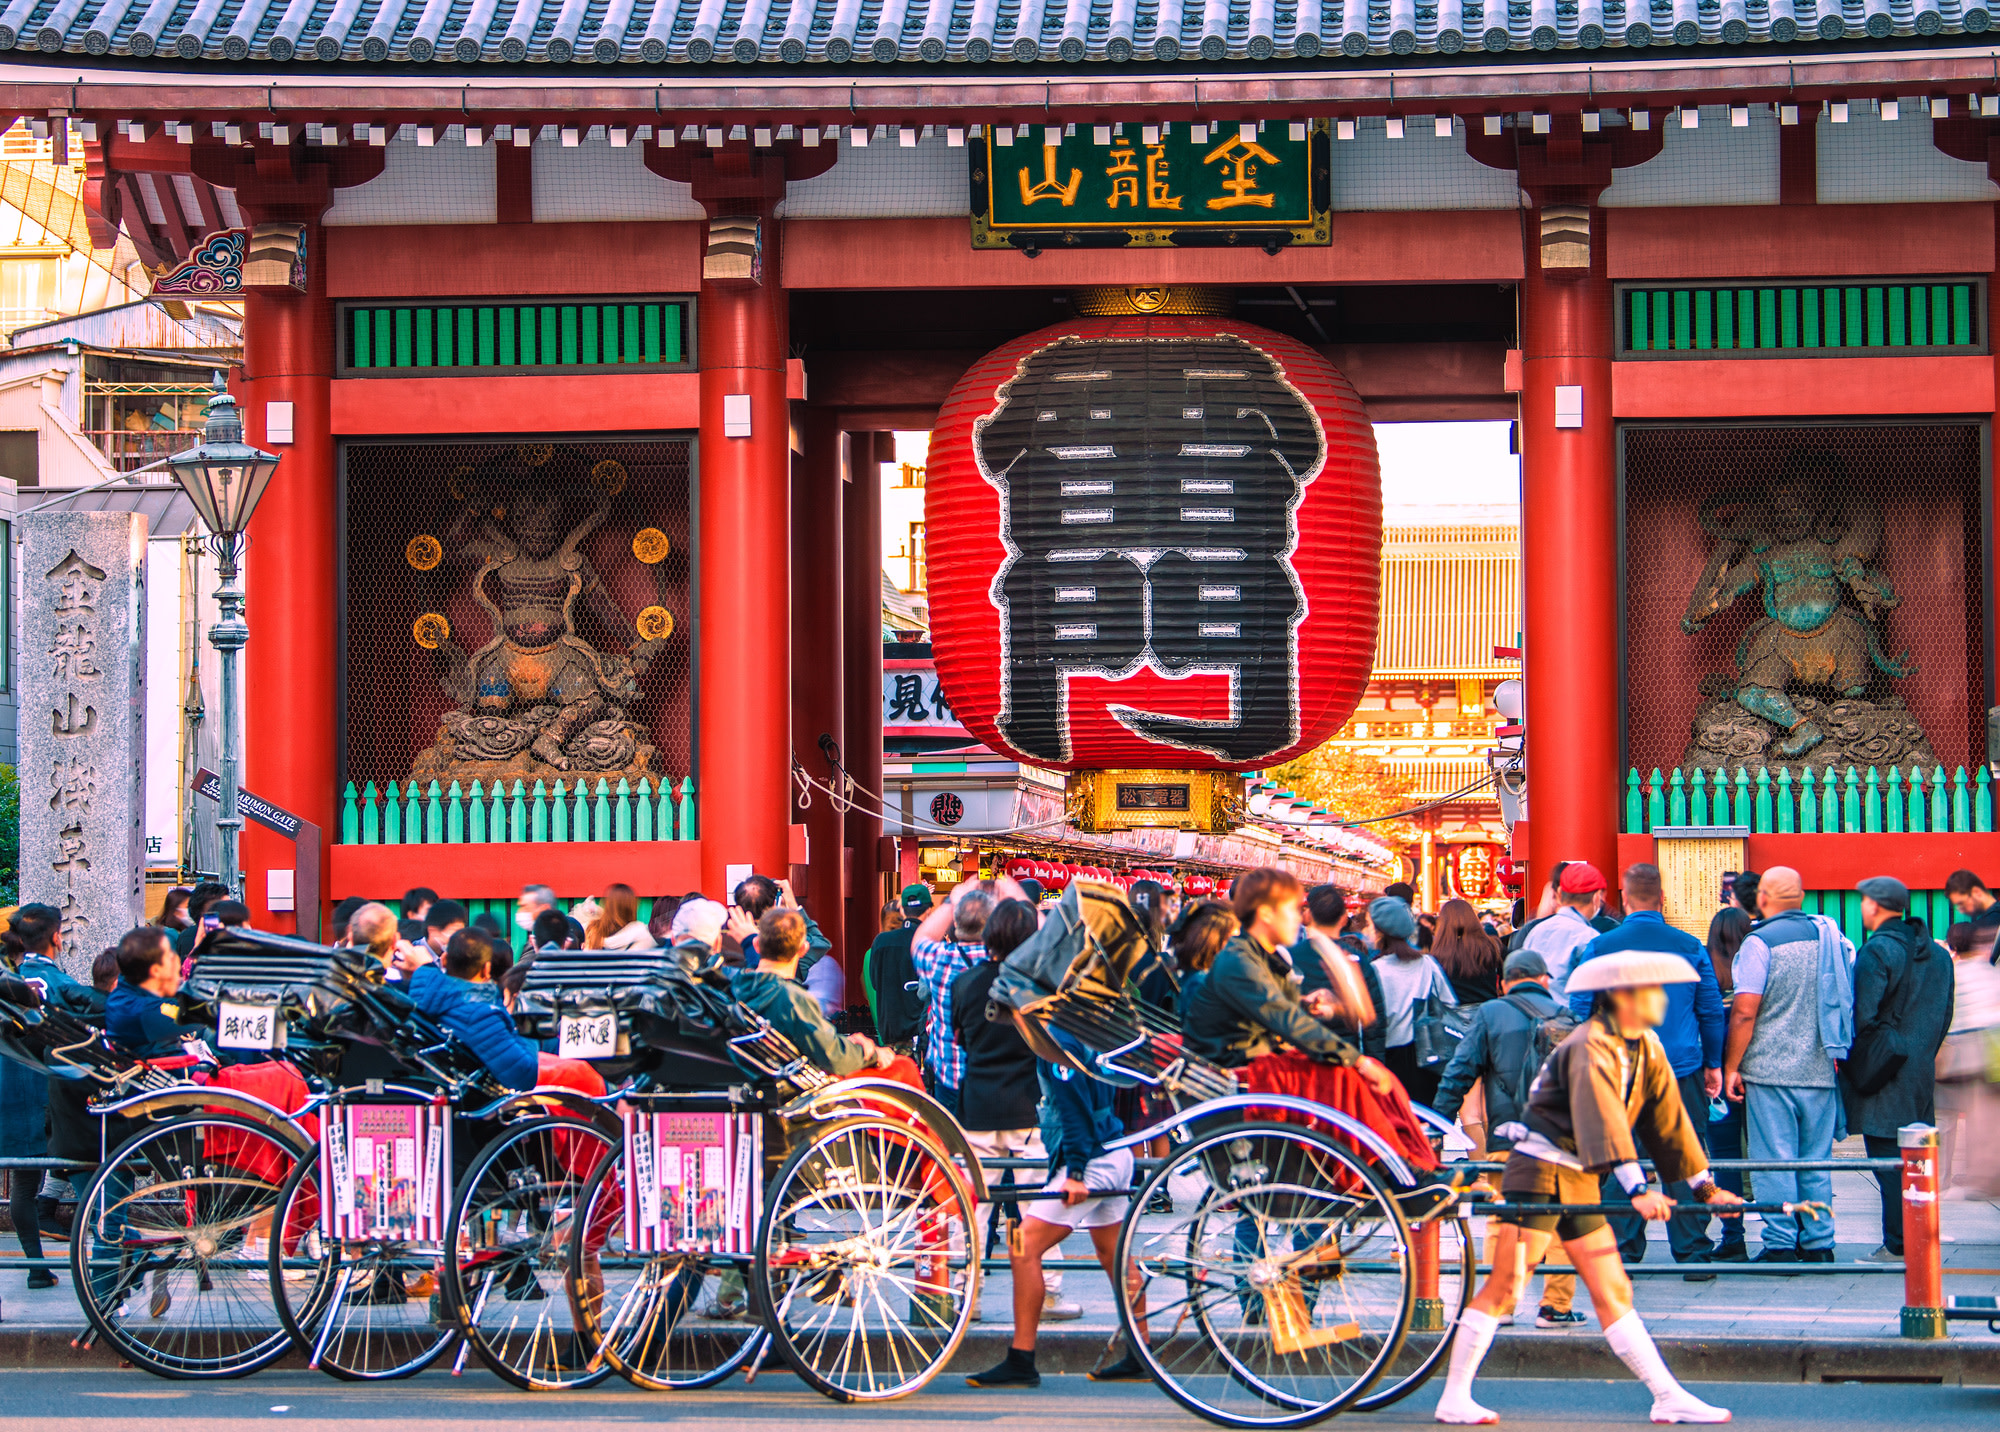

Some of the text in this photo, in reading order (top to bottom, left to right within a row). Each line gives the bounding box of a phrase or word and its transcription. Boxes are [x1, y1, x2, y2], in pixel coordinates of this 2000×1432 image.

[1121, 788, 1185, 806] 松下電器
[272, 811, 298, 828] GATE
[145, 836, 162, 854] 店
